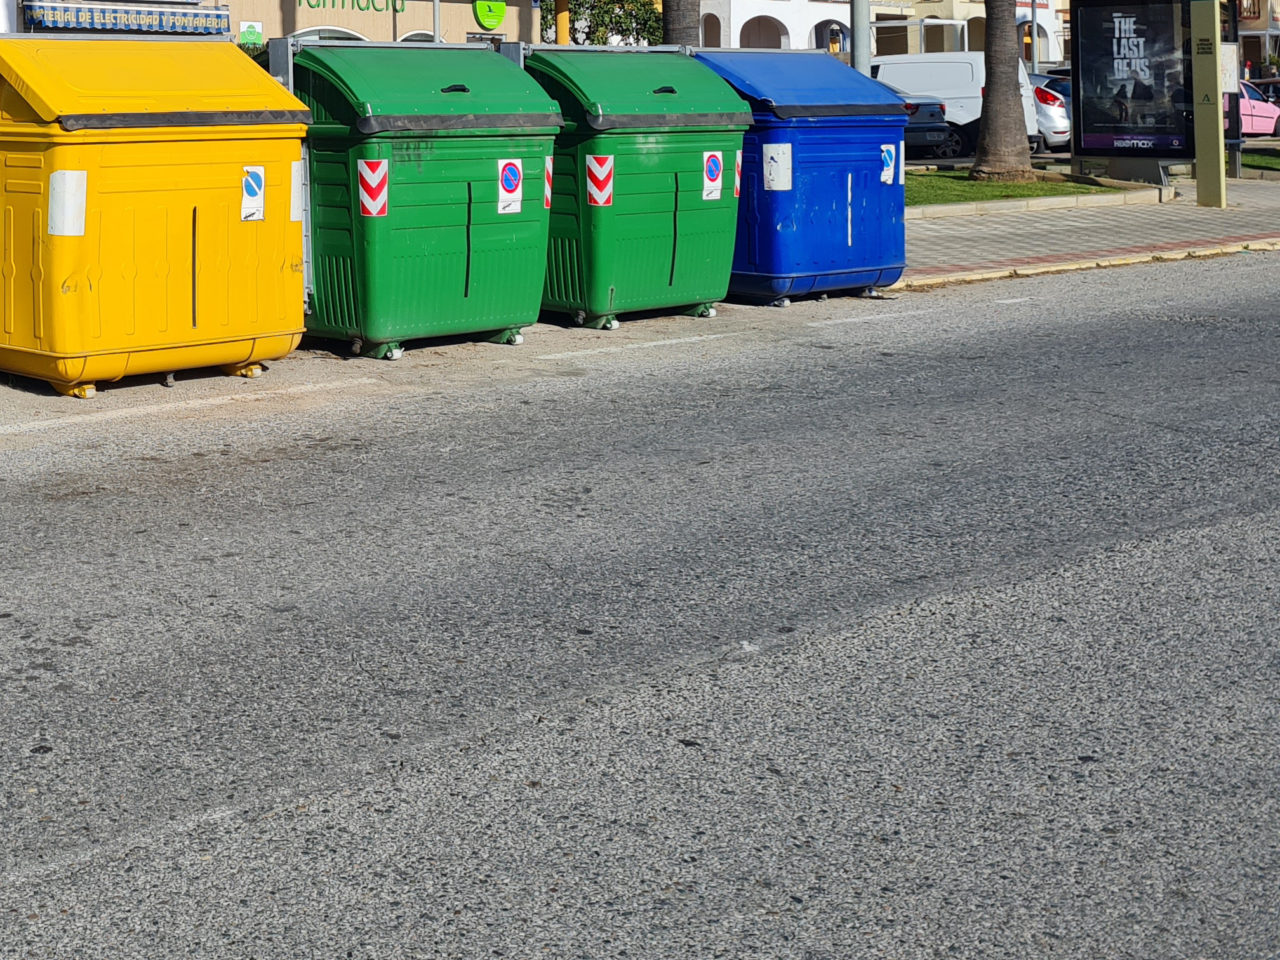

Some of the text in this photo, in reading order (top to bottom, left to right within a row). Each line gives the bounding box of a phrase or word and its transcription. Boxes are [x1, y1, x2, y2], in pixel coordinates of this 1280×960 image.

[26, 9, 228, 29] MATERIAL DE ELECTRICIDAD Y FONTANERIA
[1113, 17, 1137, 38] THE
[1112, 38, 1146, 58] LAST
[1114, 58, 1150, 79] OF US
